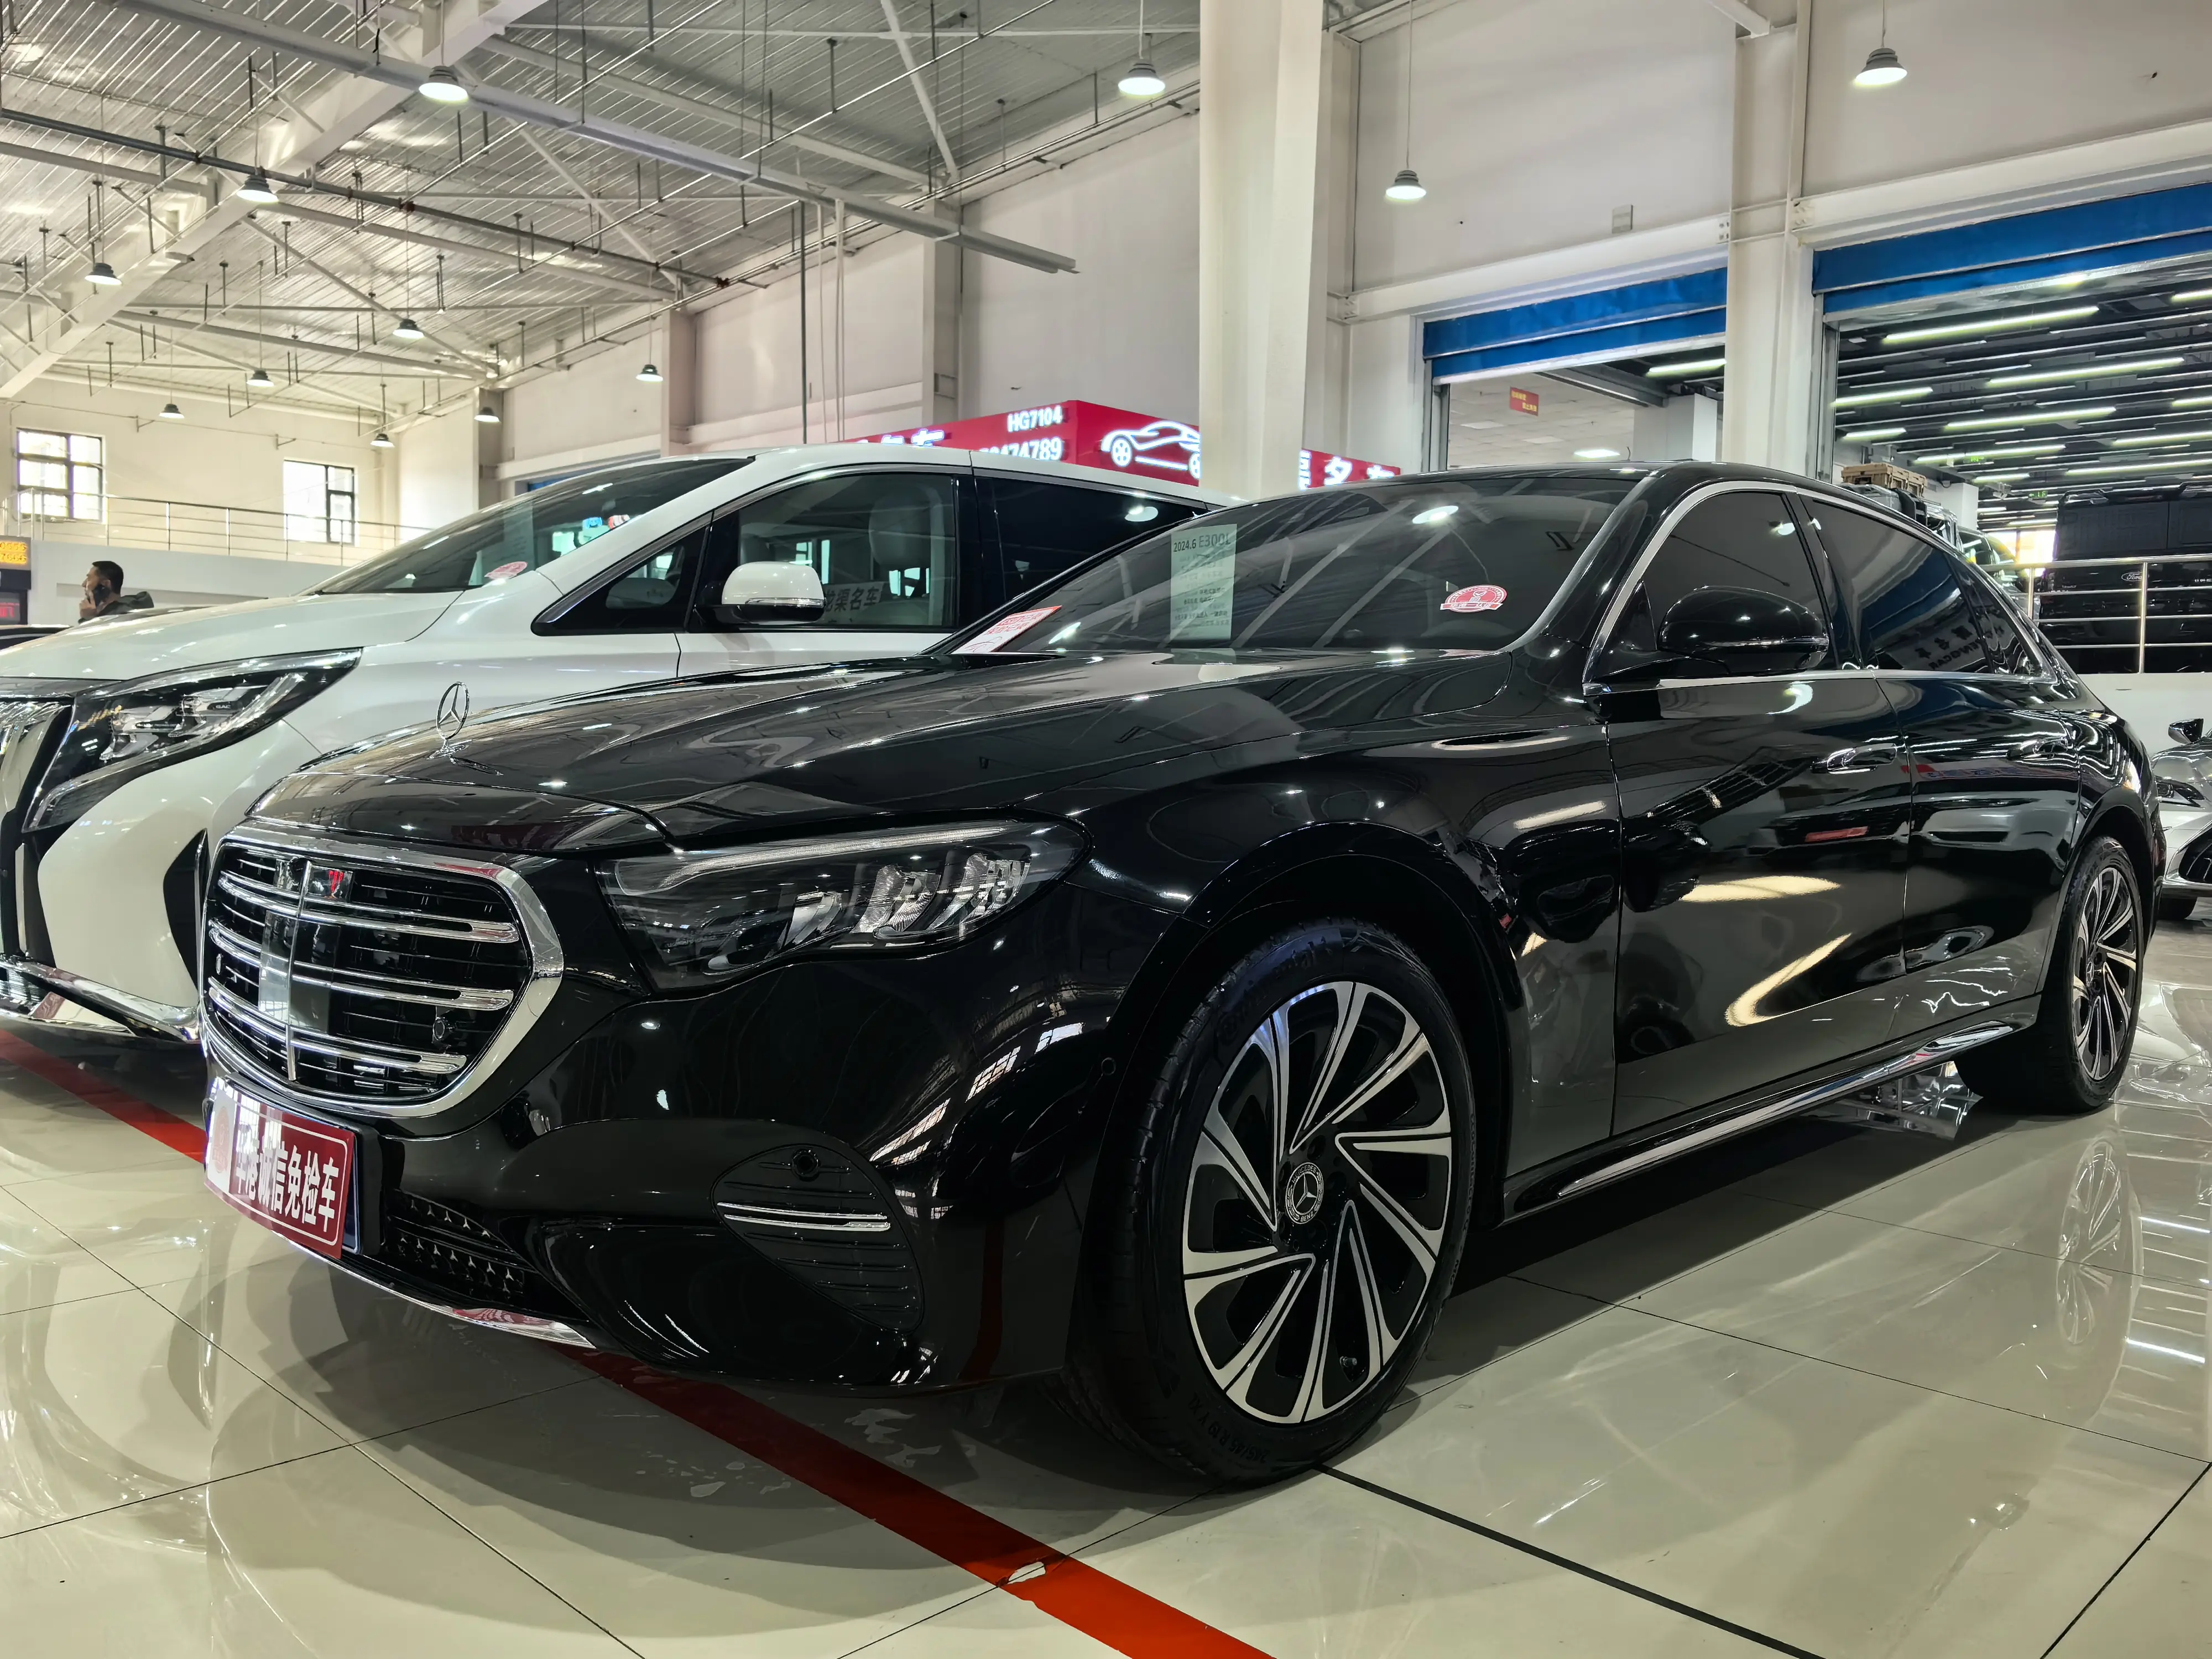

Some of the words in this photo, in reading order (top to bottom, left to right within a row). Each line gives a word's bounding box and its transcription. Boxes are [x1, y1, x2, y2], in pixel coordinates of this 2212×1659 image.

[1008, 405, 1063, 432] HG7104
[979, 436, 1062, 460] 74789
[1173, 539, 1197, 552] 2024.6
[236, 1123, 338, 1233] 信免检车
[1291, 1165, 1317, 1183] MERCEDES
[1300, 1211, 1313, 1222] BENZ
